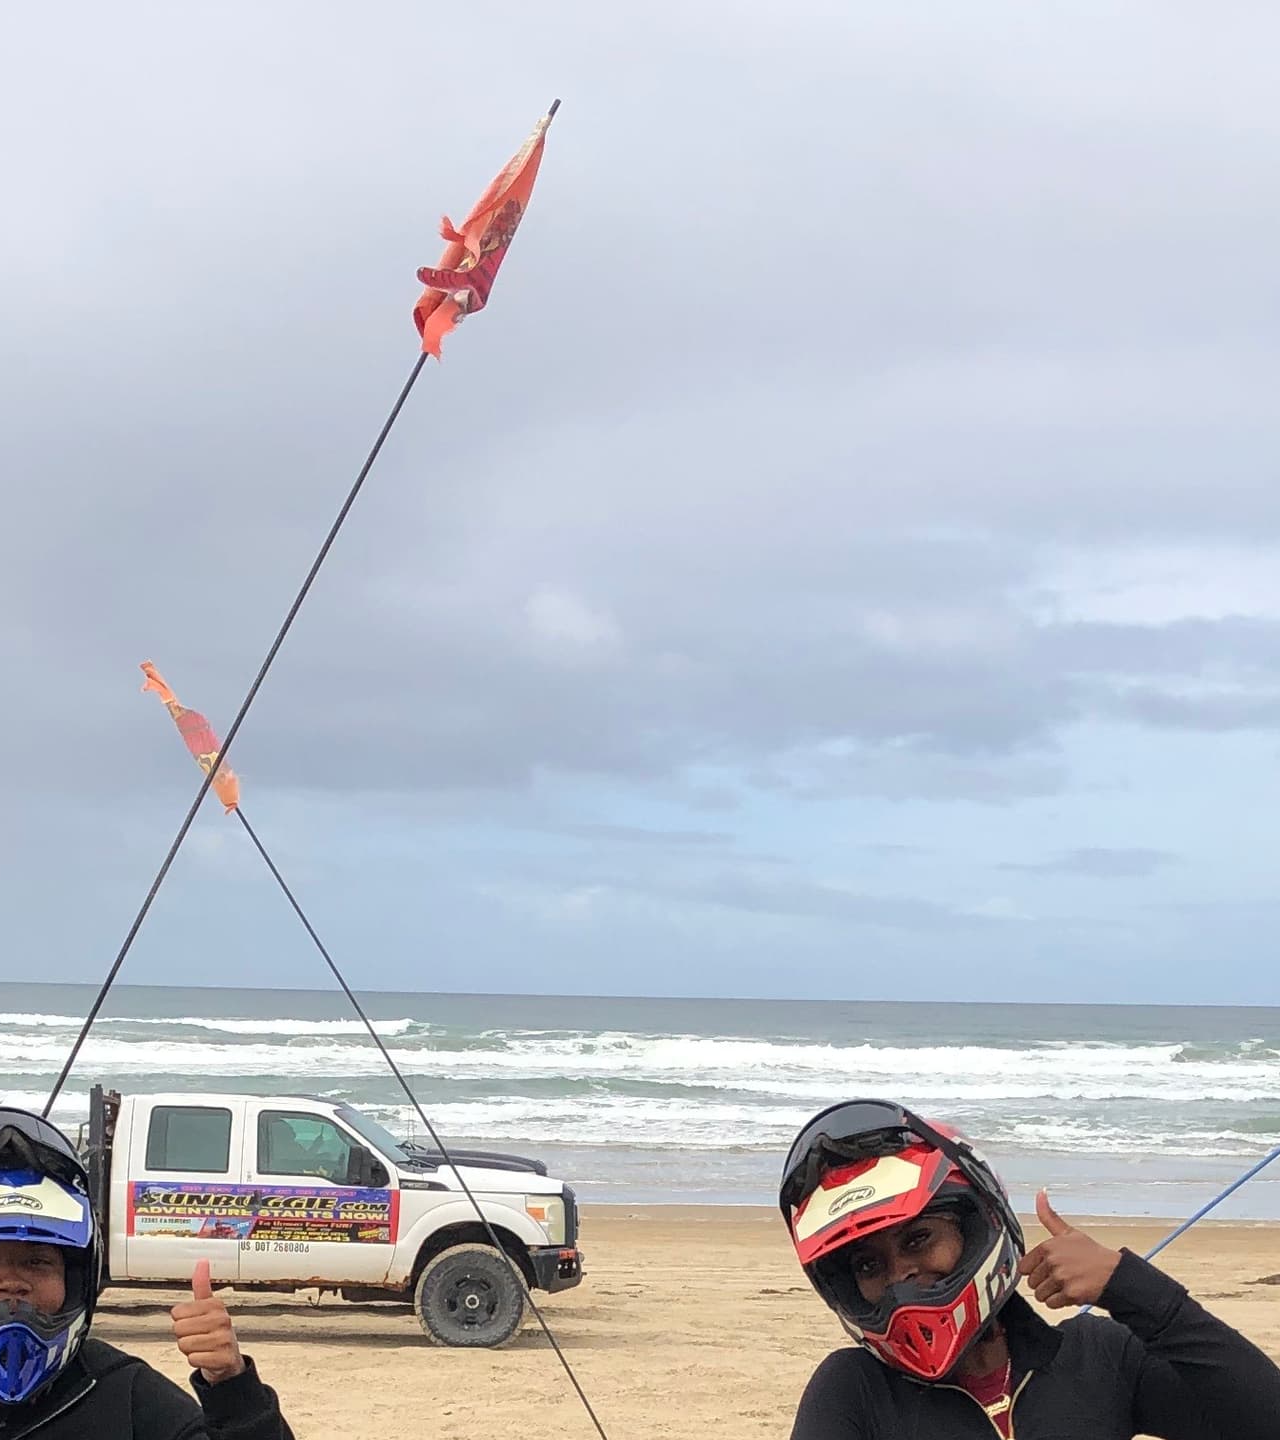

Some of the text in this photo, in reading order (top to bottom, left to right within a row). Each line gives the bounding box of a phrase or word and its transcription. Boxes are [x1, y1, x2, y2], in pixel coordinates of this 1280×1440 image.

[136, 1206, 389, 1221] ADVENTURE STARTS NOW!
[240, 1241, 251, 1251] US
[255, 1241, 270, 1252] DOT
